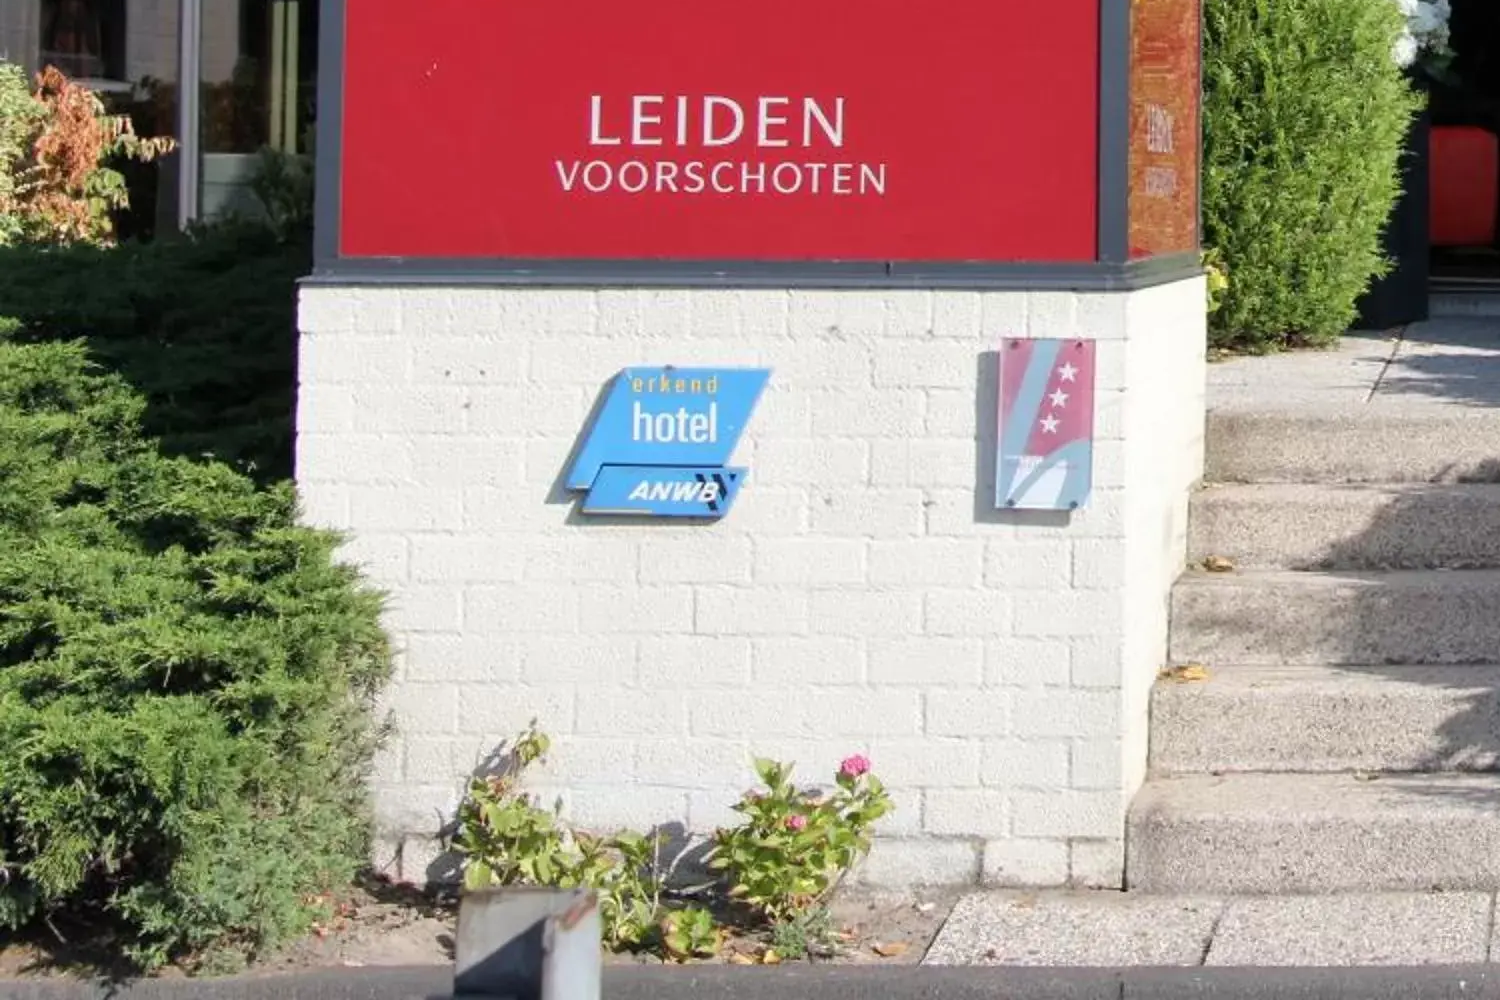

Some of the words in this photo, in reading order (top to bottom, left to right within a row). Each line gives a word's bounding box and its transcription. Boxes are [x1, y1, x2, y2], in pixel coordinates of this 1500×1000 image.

[588, 94, 845, 148] LEIDEN
[553, 160, 887, 195] VOORSCHOTEN
[631, 375, 719, 393] erkend
[632, 400, 718, 443] hotel
[627, 479, 721, 504] ANWB
